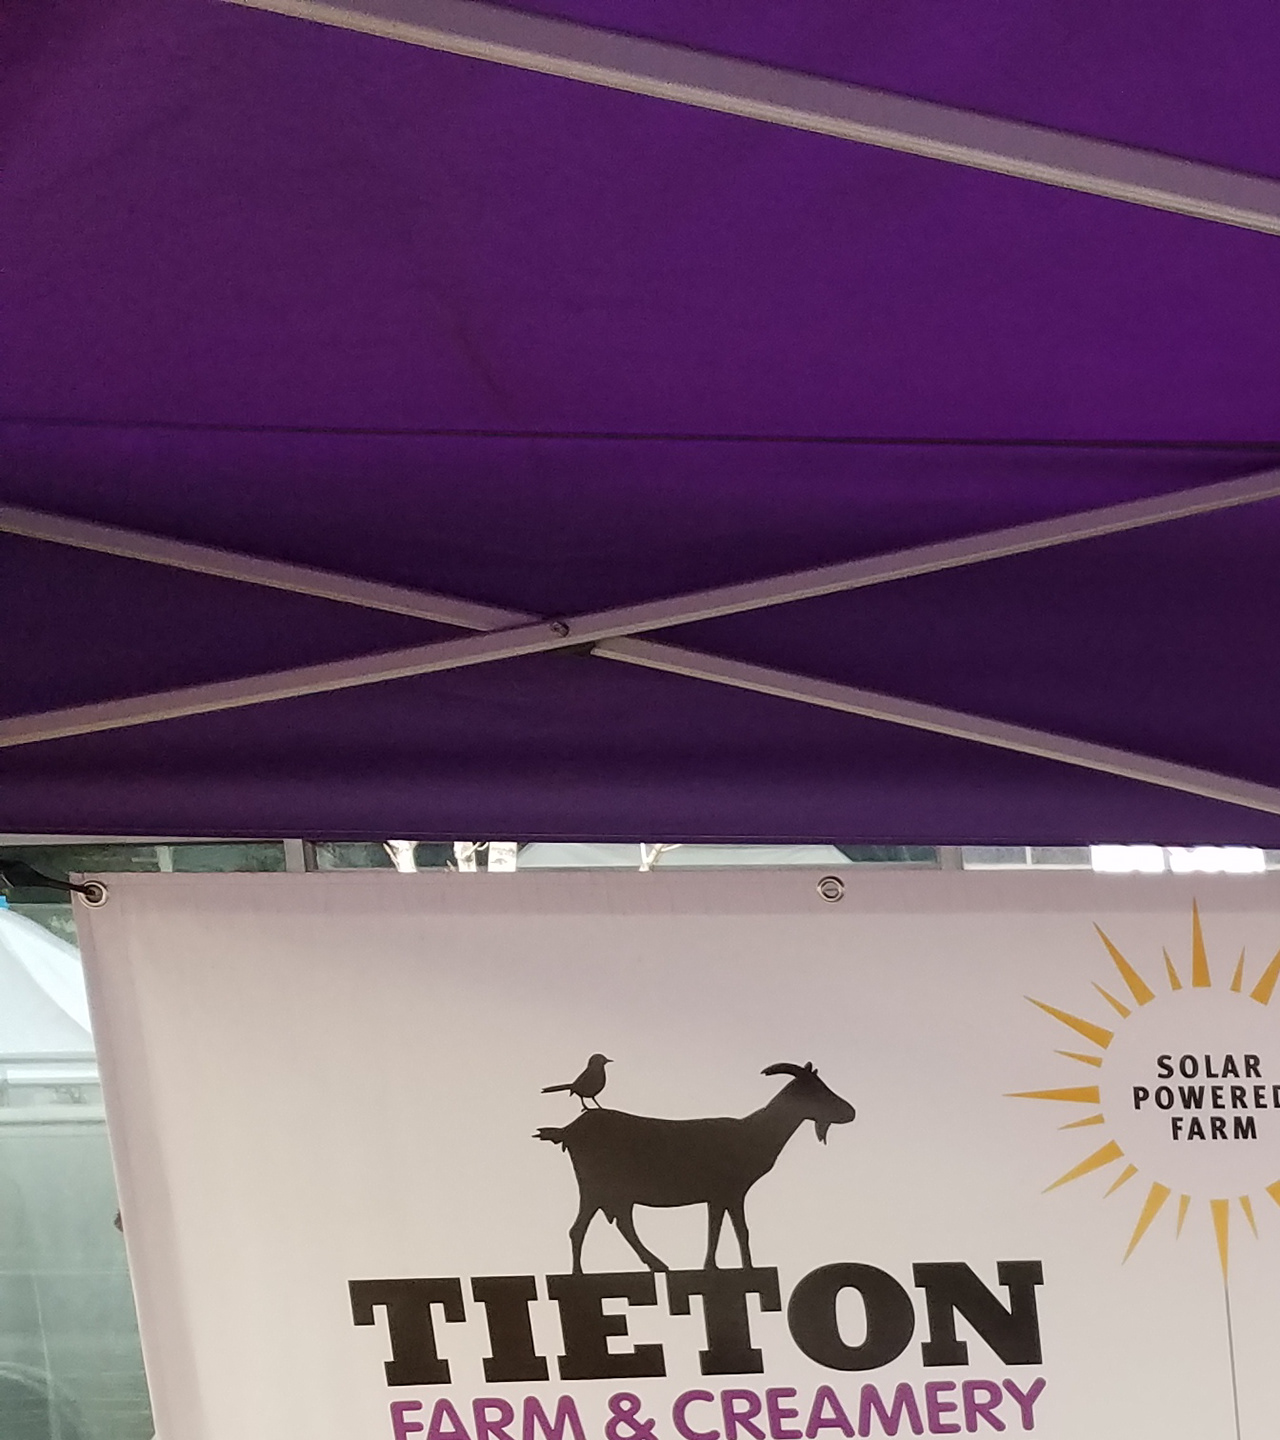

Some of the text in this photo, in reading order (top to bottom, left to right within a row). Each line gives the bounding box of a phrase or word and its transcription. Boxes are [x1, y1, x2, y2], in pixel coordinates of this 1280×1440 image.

[1156, 1054, 1262, 1079] SOLAR
[1171, 1115, 1258, 1141] FARM
[348, 1260, 1045, 1387] TIETON
